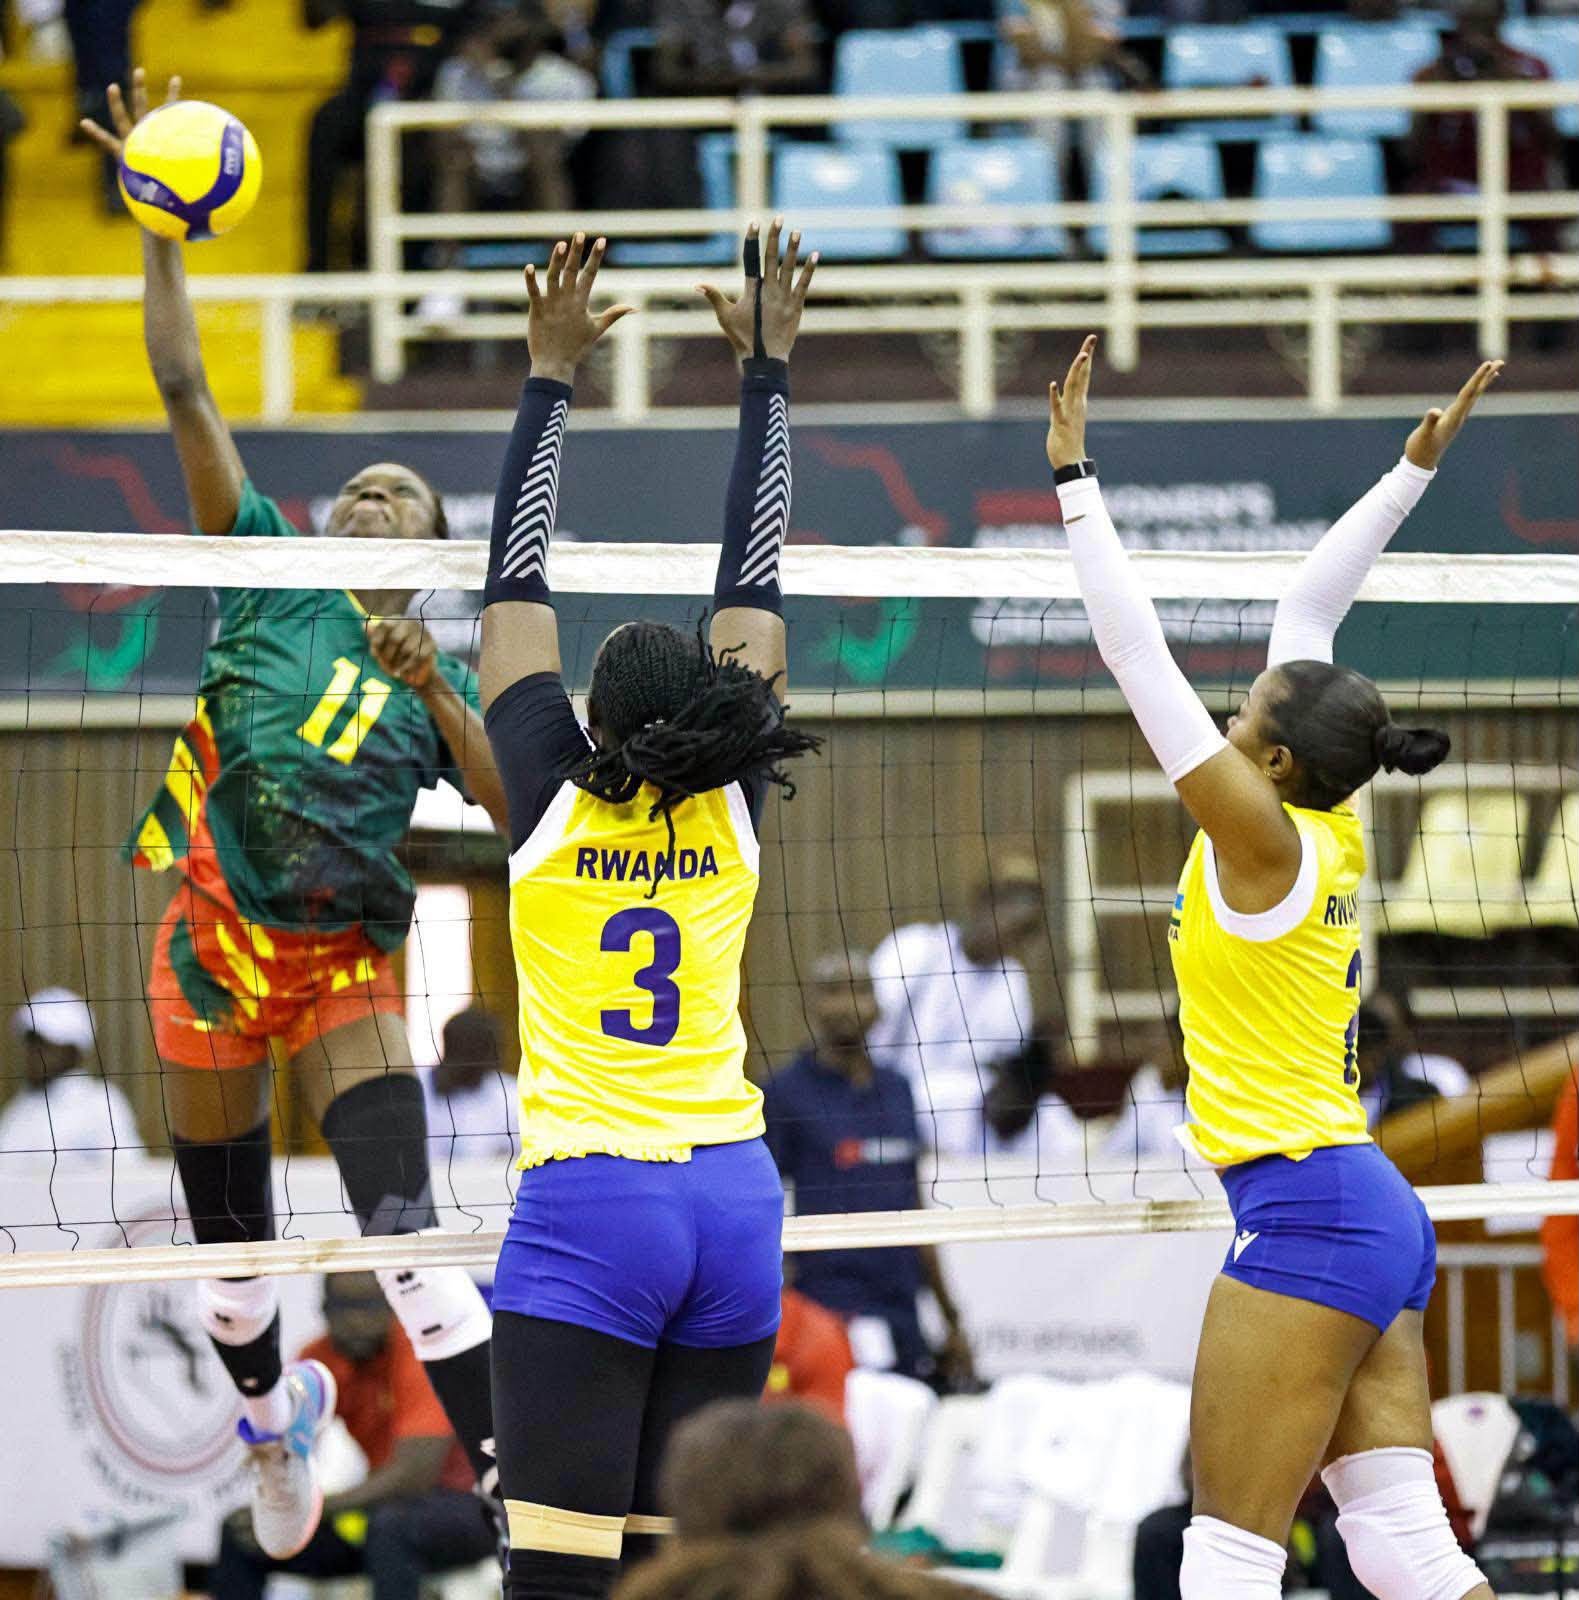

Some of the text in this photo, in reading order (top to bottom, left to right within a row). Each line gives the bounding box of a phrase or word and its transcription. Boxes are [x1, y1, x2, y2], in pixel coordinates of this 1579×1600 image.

[296, 656, 392, 766] 11
[575, 846, 719, 881] RWANDA
[600, 907, 681, 1046] 3
